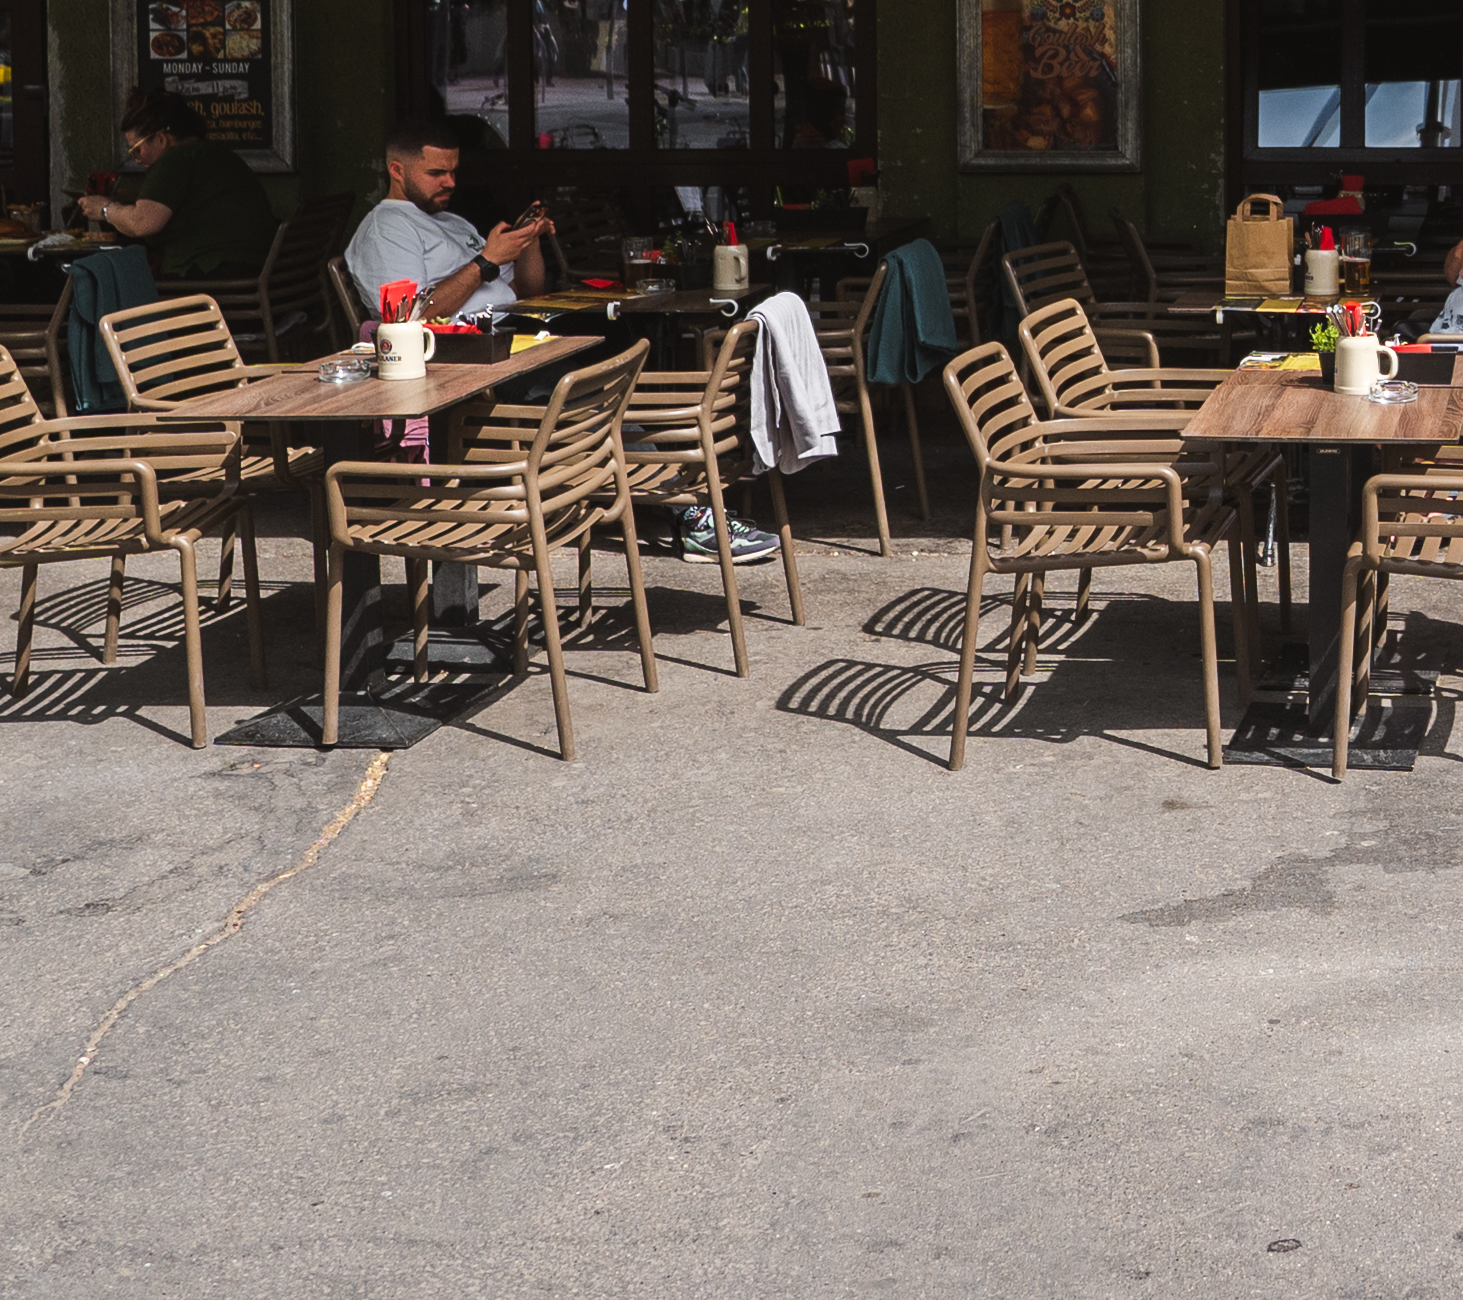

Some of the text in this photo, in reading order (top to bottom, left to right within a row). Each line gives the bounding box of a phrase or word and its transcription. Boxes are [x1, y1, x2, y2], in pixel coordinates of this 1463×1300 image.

[1028, 23, 1109, 49] Goulash
[163, 62, 203, 74] MONDAY
[212, 62, 251, 74] SUNDAY
[1030, 46, 1101, 79] Beer
